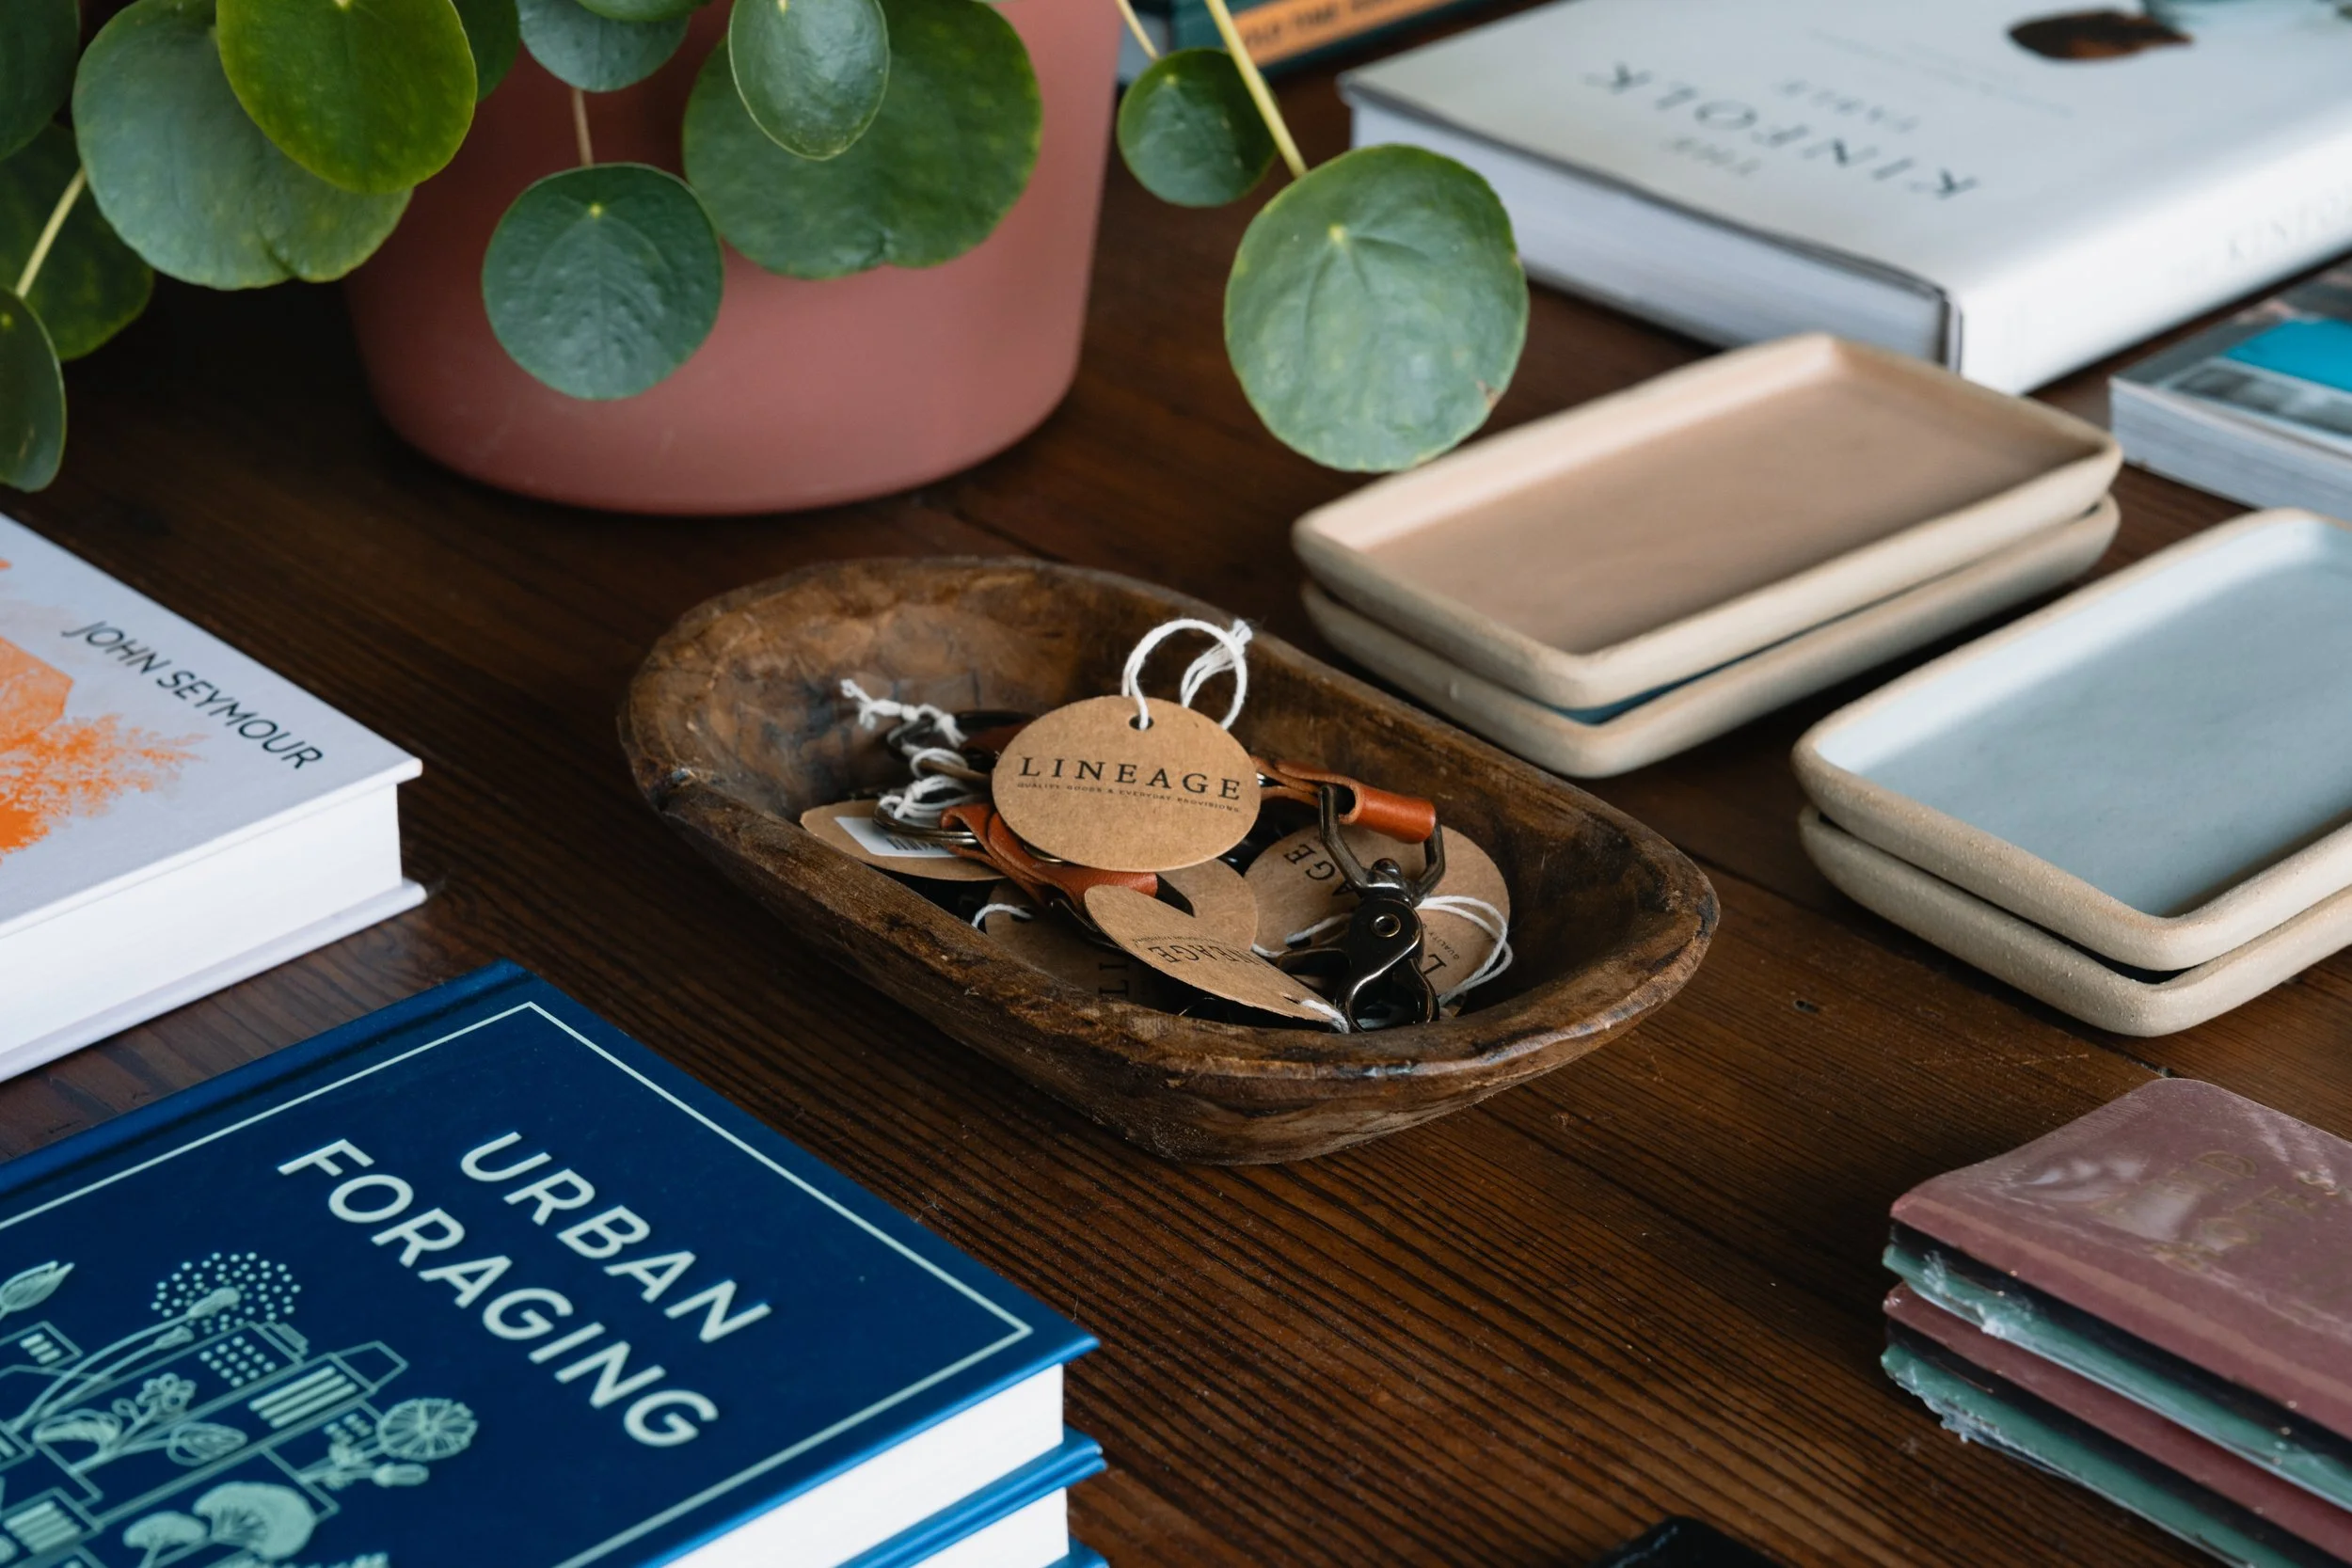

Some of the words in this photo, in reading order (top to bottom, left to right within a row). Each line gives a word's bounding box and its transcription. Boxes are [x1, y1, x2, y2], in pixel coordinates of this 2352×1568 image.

[1584, 62, 1979, 198] KINFOLK
[61, 621, 171, 674] JOHN
[156, 670, 323, 769] SEYMOUR
[1019, 757, 1240, 800] LINEAGE
[1120, 790, 1171, 801] EVERYDAY
[1177, 797, 1240, 813] PROVISIONS
[277, 1138, 719, 1448] FORAGING
[460, 1132, 772, 1343] URBAN
